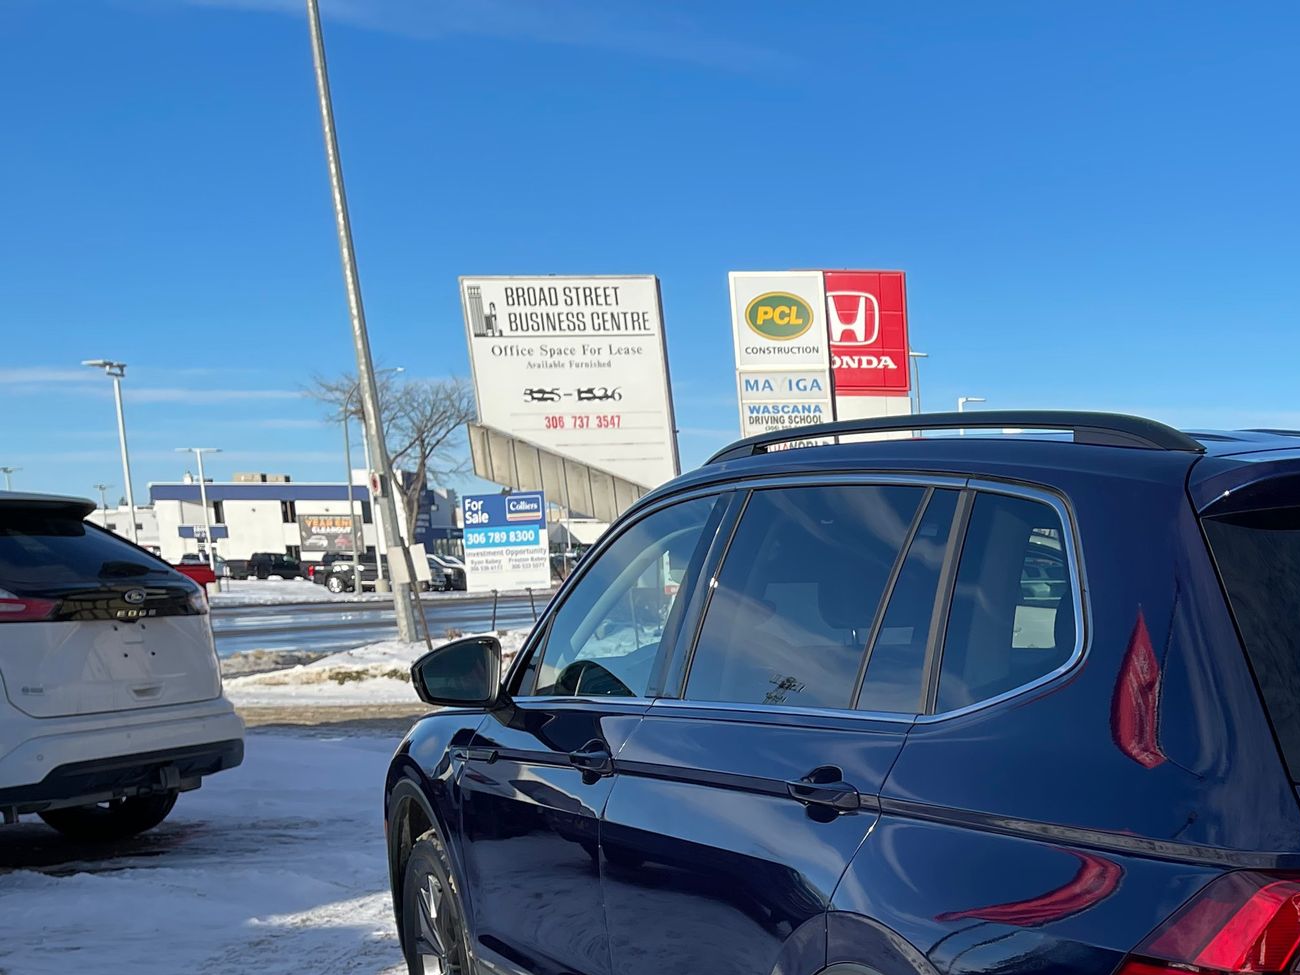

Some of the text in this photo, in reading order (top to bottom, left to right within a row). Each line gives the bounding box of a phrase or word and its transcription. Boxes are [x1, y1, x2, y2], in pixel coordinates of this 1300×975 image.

[504, 286, 620, 306] BROAD STREET
[508, 311, 651, 332] BUSINESS CENTRE
[757, 305, 803, 325] PCL
[491, 343, 643, 358] Office Space For Lease
[744, 346, 819, 355] CONSTRUCTION
[526, 360, 612, 369] Available Furnished
[831, 355, 898, 369] ONDA
[748, 404, 823, 414] WASCANA
[544, 415, 621, 429] 306 737 3547
[749, 415, 823, 425] DRIVING SCHOOL
[465, 498, 538, 511] For Colliers
[465, 511, 489, 524] Sale
[467, 530, 535, 545] 306 789 8300
[505, 548, 547, 557] Opportunity
